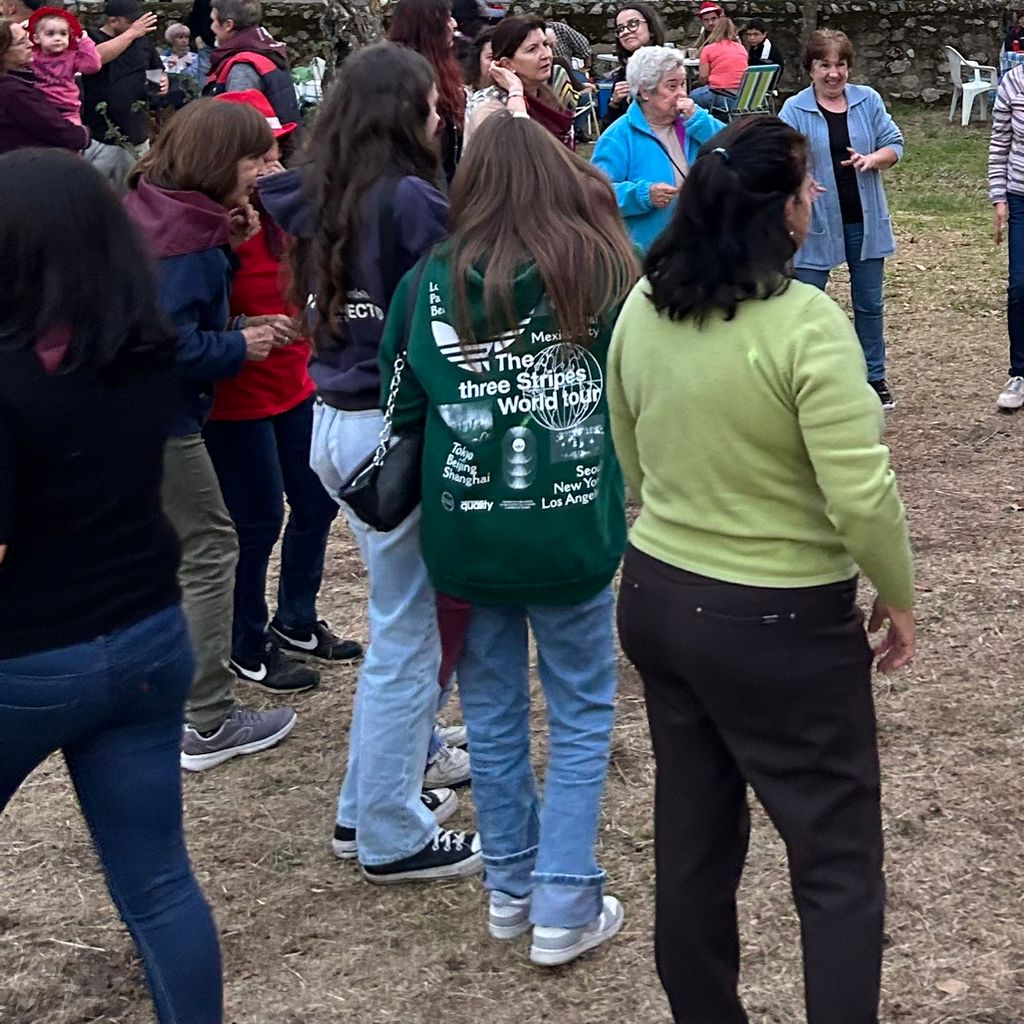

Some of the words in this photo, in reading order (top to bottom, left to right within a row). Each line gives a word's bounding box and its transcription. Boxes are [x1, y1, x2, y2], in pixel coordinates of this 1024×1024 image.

[495, 352, 535, 371] The
[459, 379, 511, 399] three
[516, 367, 586, 391] Stripes
[497, 391, 557, 415] World
[562, 387, 601, 407] tour
[451, 441, 474, 463] Tokyo
[446, 453, 478, 476] Beijing
[442, 466, 491, 487] Shanghai
[553, 481, 582, 494] New
[460, 500, 494, 512] quality
[541, 497, 563, 509] Los
